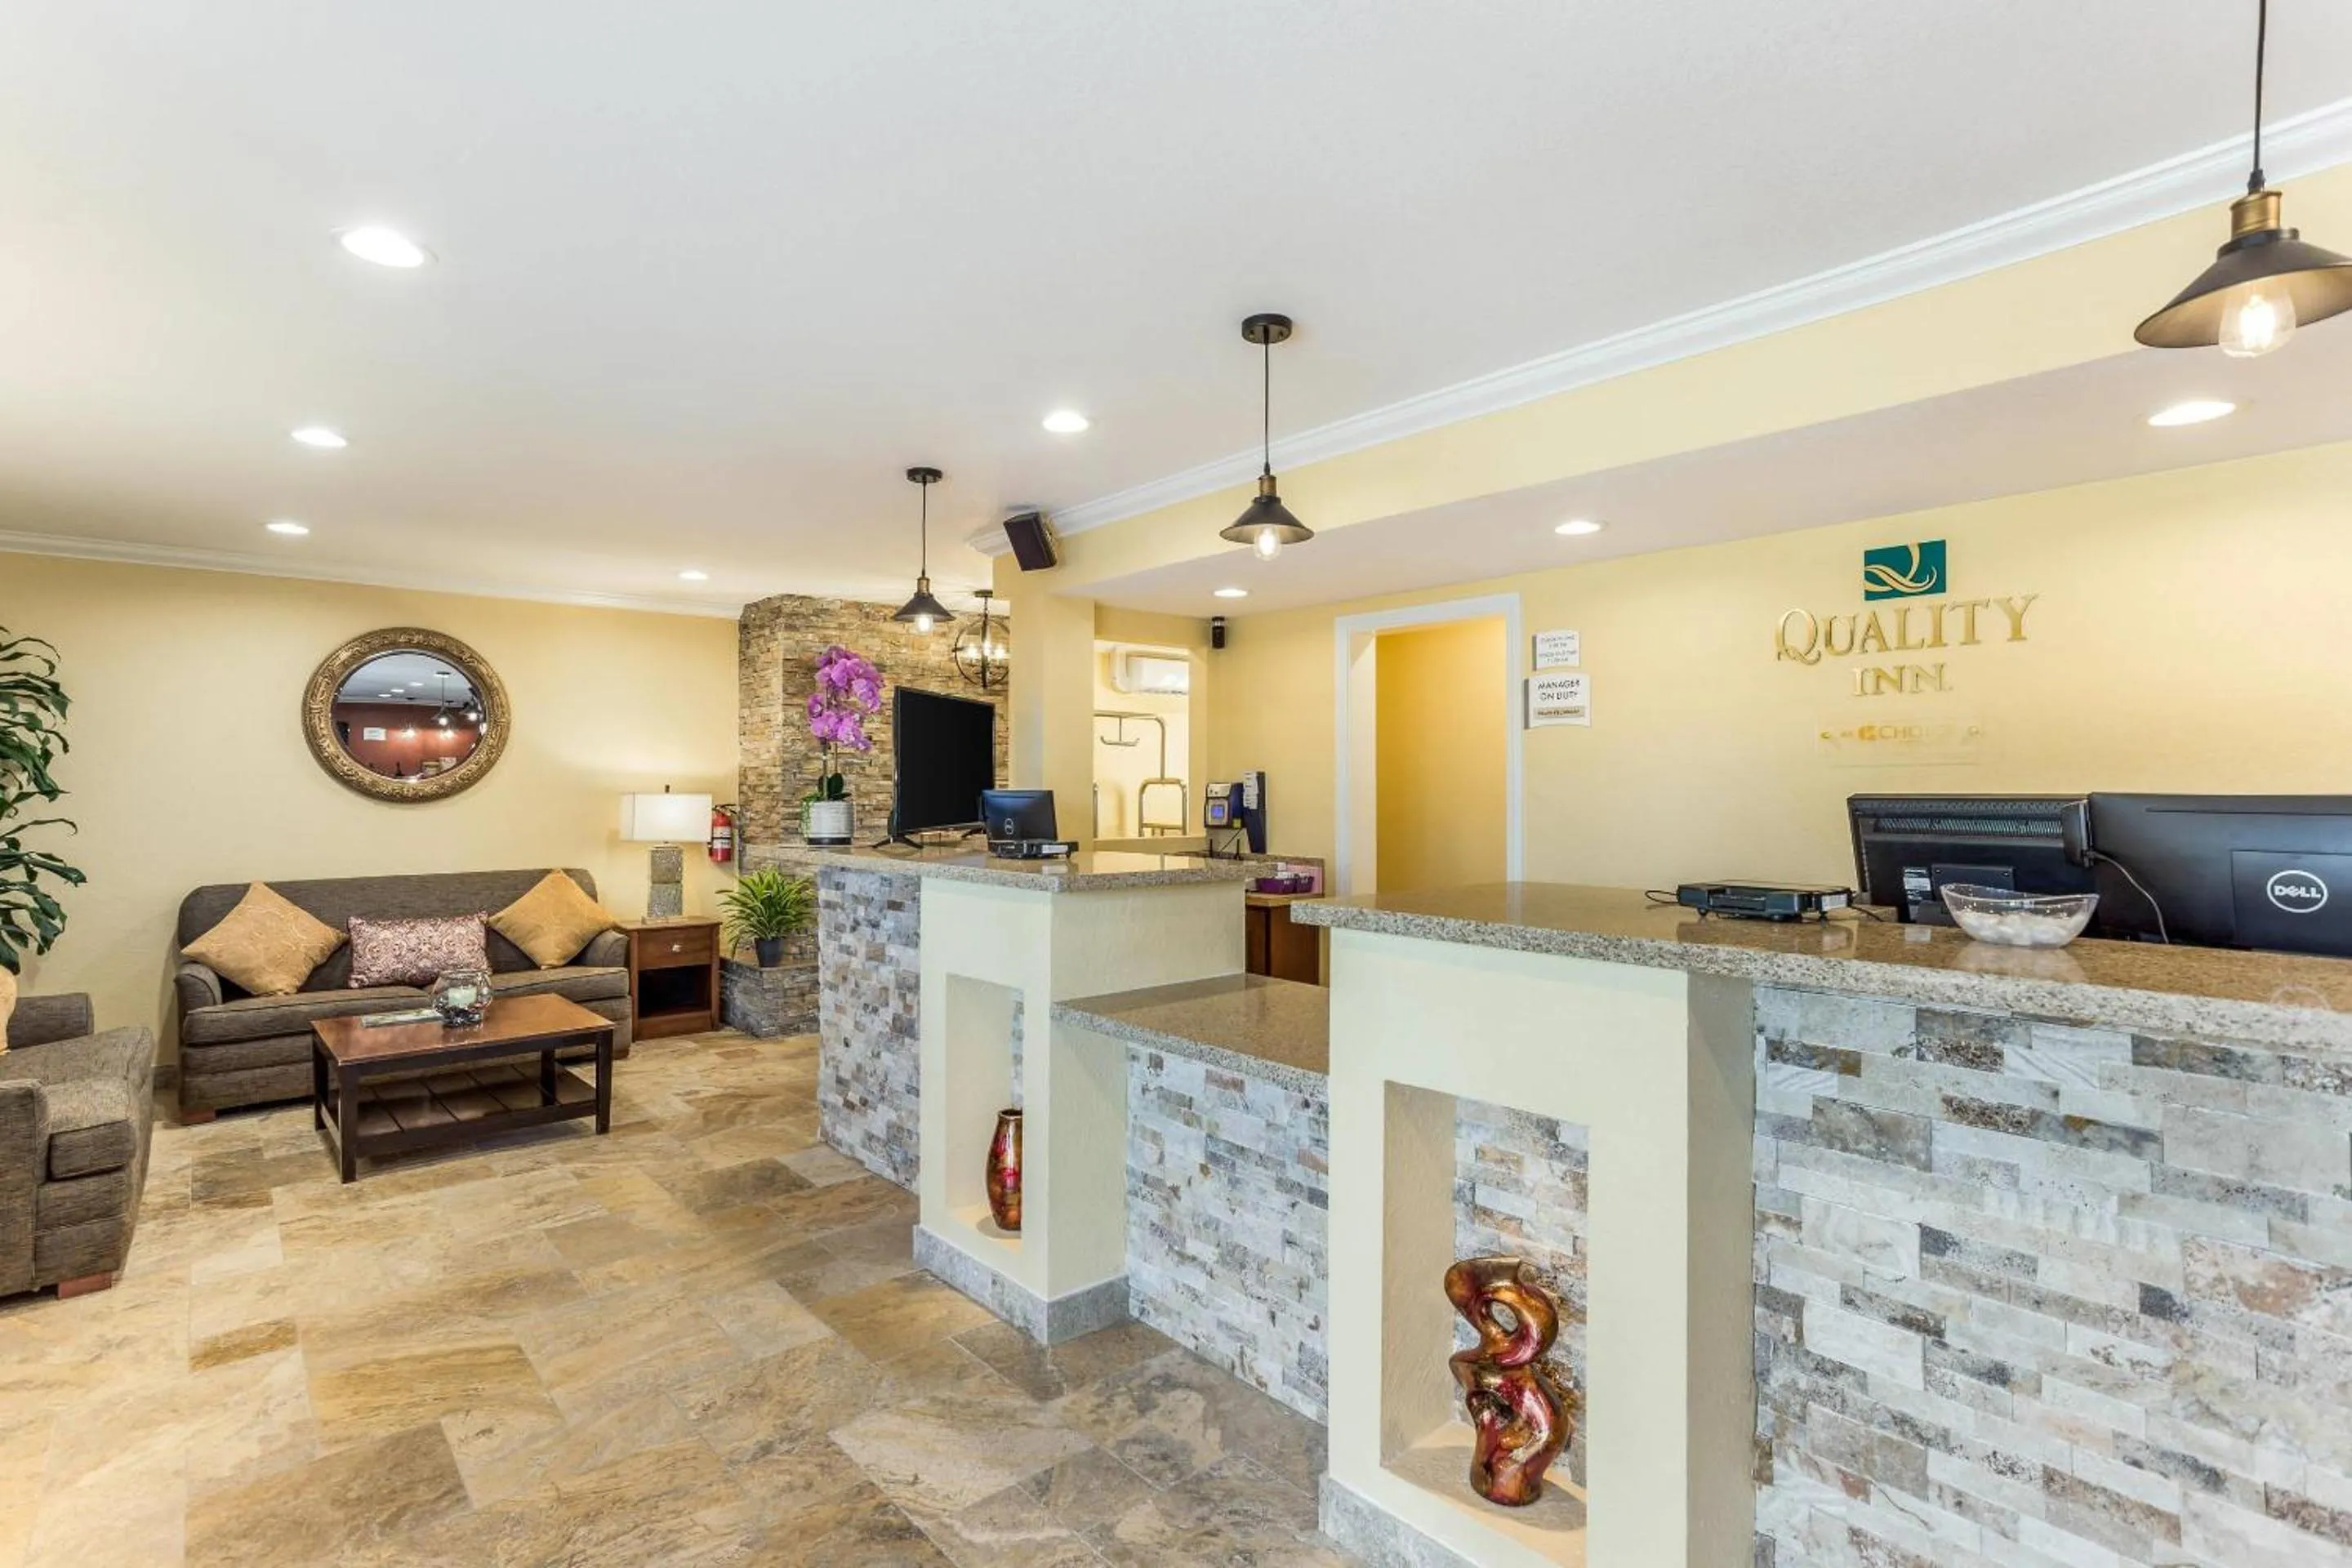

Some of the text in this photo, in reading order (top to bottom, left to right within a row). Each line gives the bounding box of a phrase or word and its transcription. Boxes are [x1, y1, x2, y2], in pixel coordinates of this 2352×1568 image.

[1775, 594, 2038, 666] QUALITY
[1538, 679, 1580, 690] MANAGER
[1852, 662, 1947, 696] INN
[1540, 691, 1578, 702] ON DUTY
[2274, 885, 2322, 898] DELL
